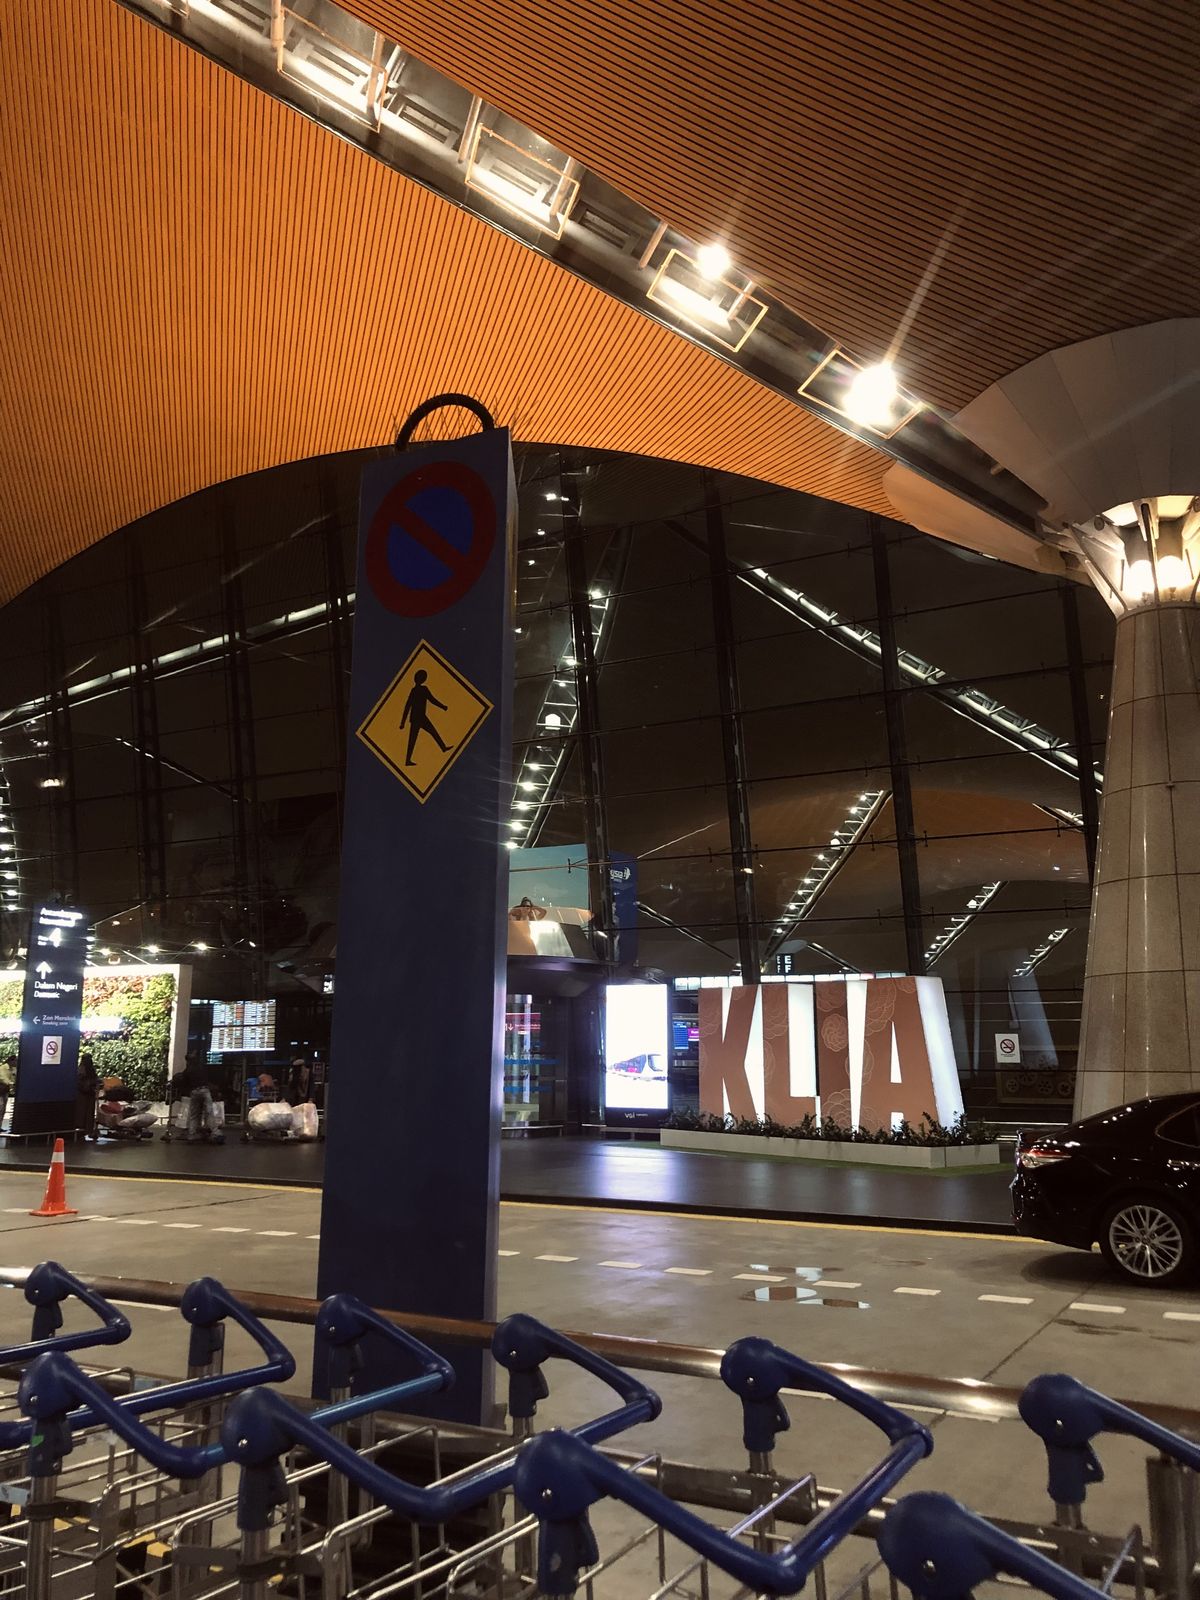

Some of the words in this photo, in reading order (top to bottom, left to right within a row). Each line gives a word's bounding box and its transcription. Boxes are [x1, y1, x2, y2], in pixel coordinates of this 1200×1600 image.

[784, 955, 792, 964] E
[784, 964, 792, 973] F
[698, 976, 945, 1136] KLIA
